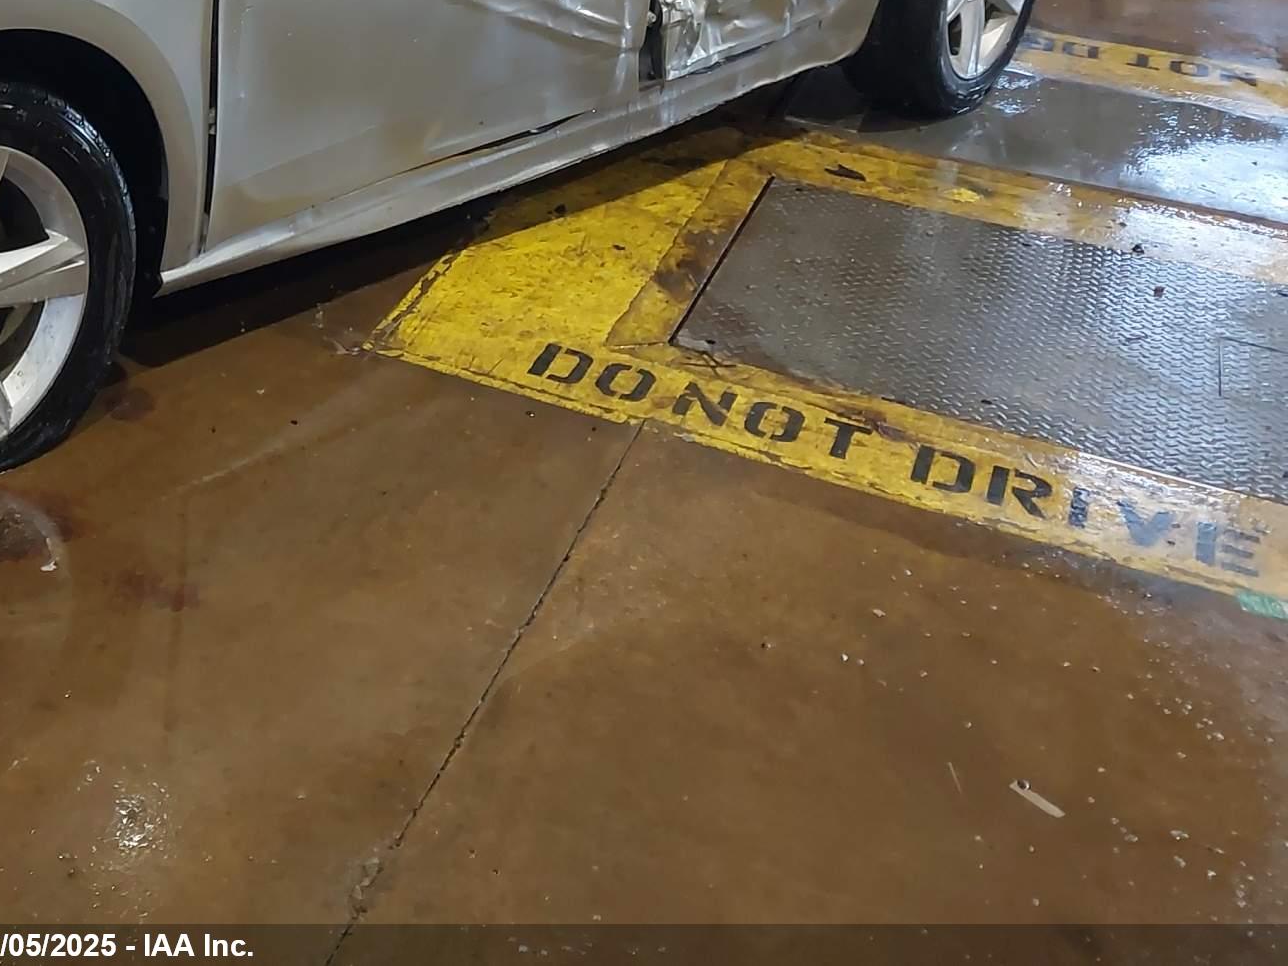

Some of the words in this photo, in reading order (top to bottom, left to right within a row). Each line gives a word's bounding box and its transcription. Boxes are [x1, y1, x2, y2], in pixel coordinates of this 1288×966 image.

[527, 342, 657, 403] DO
[672, 382, 873, 460] NOT
[911, 445, 1262, 578] DRIVE
